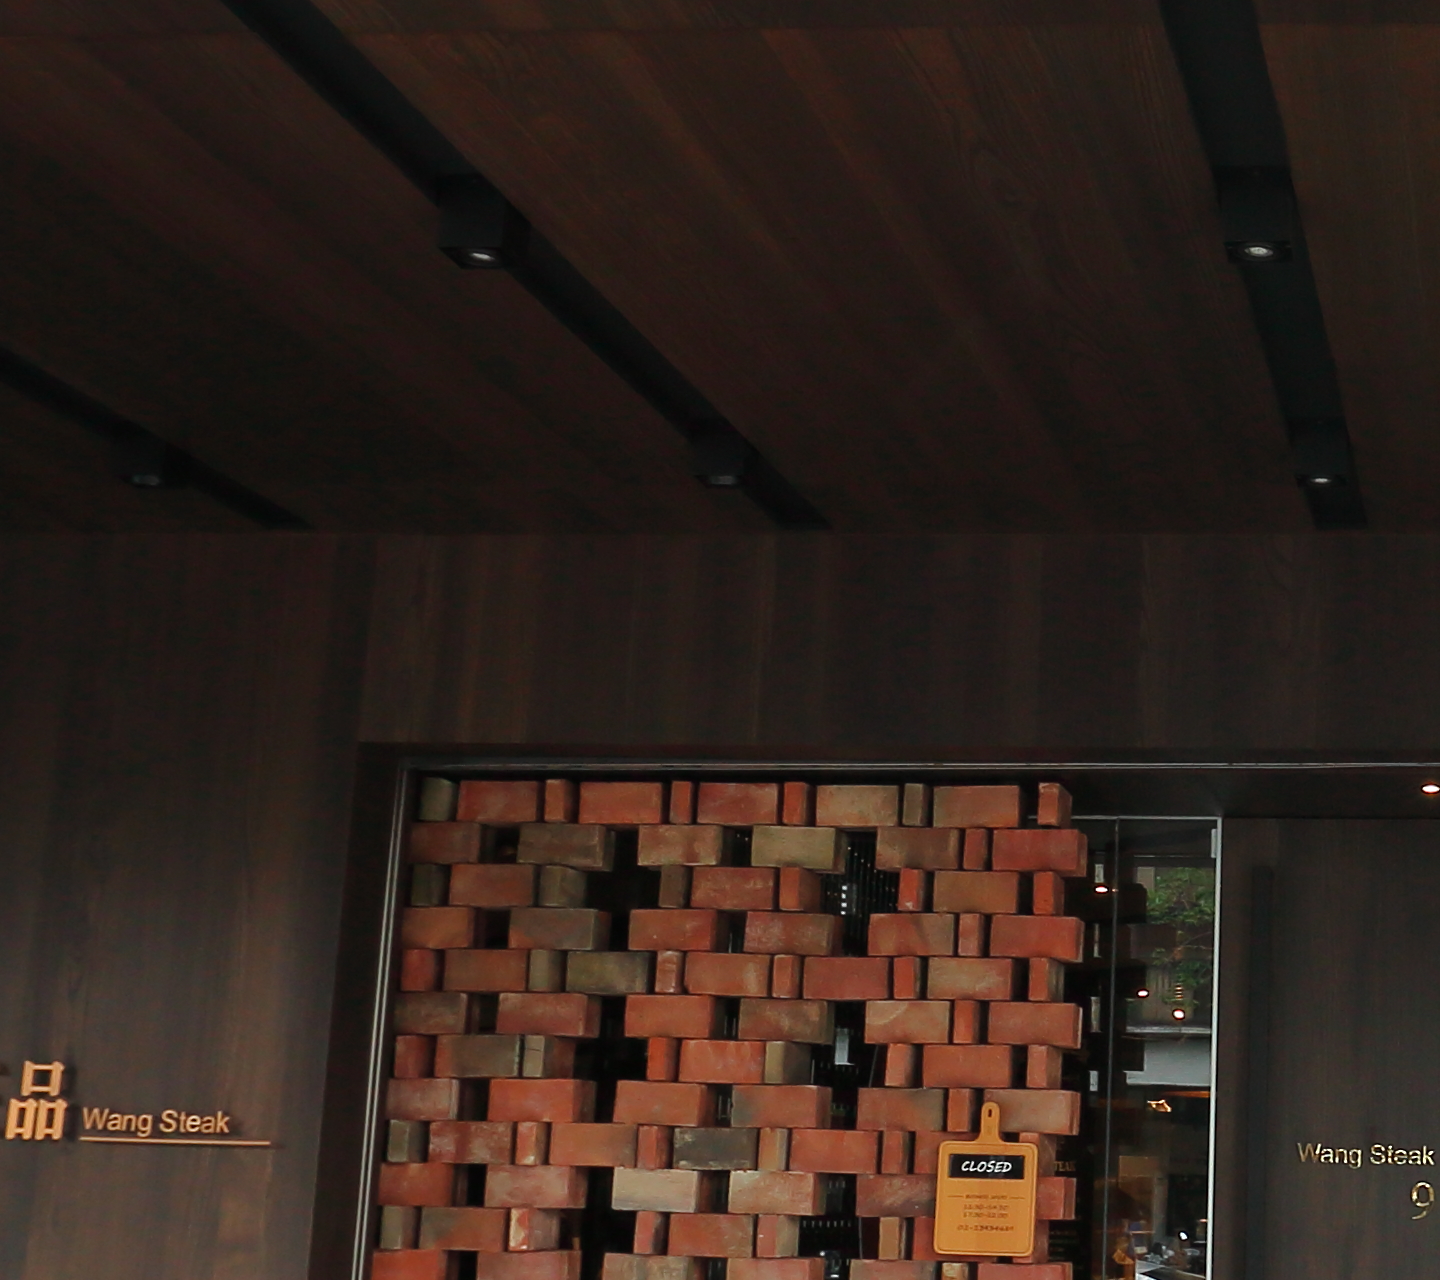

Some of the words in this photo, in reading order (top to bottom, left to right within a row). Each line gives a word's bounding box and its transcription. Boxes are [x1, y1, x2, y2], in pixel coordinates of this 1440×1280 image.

[82, 1107, 153, 1137] Wang
[159, 1109, 230, 1134] Steak
[961, 1160, 1012, 1173] CLOSED
[1297, 1142, 1363, 1169] Wang
[1369, 1143, 1436, 1166] Steak
